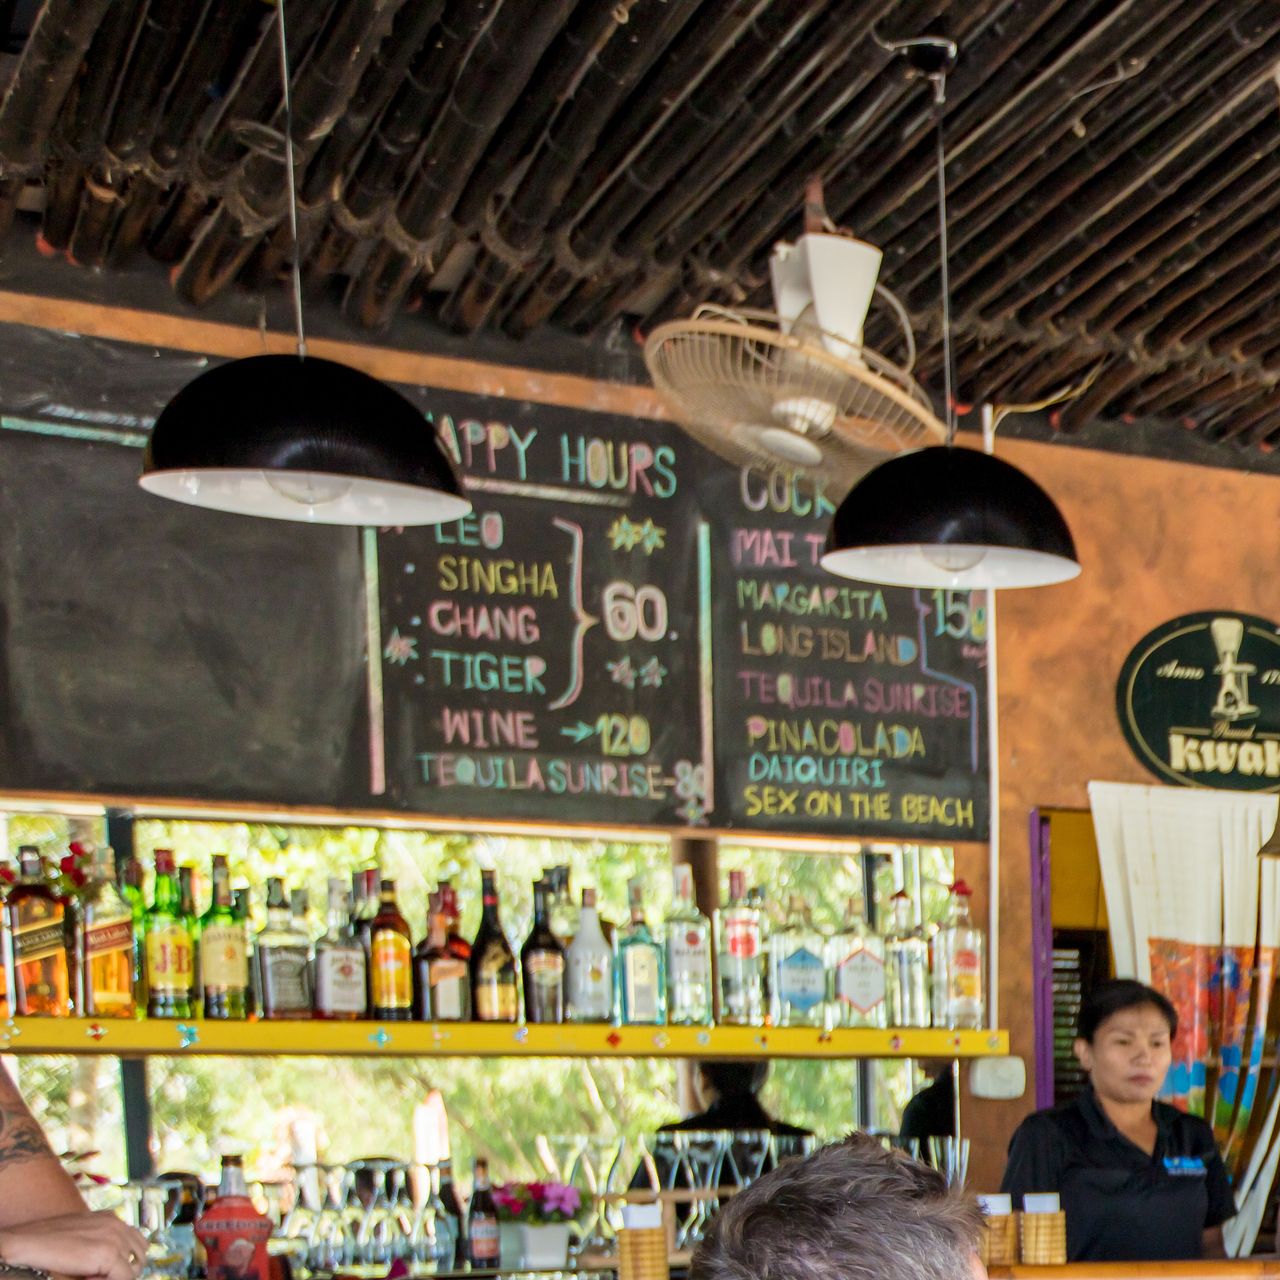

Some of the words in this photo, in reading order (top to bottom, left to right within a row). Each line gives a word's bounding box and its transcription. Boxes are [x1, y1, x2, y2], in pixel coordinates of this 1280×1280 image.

[424, 411, 538, 481] APPY
[560, 432, 677, 498] HOURS
[740, 464, 836, 519] COCK
[435, 512, 504, 549] LEO
[734, 528, 797, 568] MAI
[805, 532, 827, 566] T
[438, 555, 559, 600] SINGHA
[736, 578, 888, 622] MARGARITA
[428, 600, 540, 644] CHANG
[604, 580, 668, 642] 60
[931, 588, 989, 643] 150
[741, 620, 814, 659] LONG
[817, 627, 918, 667] ISLAND
[431, 650, 547, 695] TIGER
[1157, 659, 1205, 681] Anno
[737, 671, 859, 711] TEQUILA
[863, 676, 970, 718] SUNRISE
[440, 706, 540, 750] WINE
[596, 713, 651, 757] 120
[417, 753, 546, 792] TEQUILA
[749, 752, 887, 788] DAIQUIRI
[744, 785, 799, 817] SEX
[805, 790, 842, 818] ON
[852, 792, 893, 821] THE
[902, 792, 976, 829] BEACH
